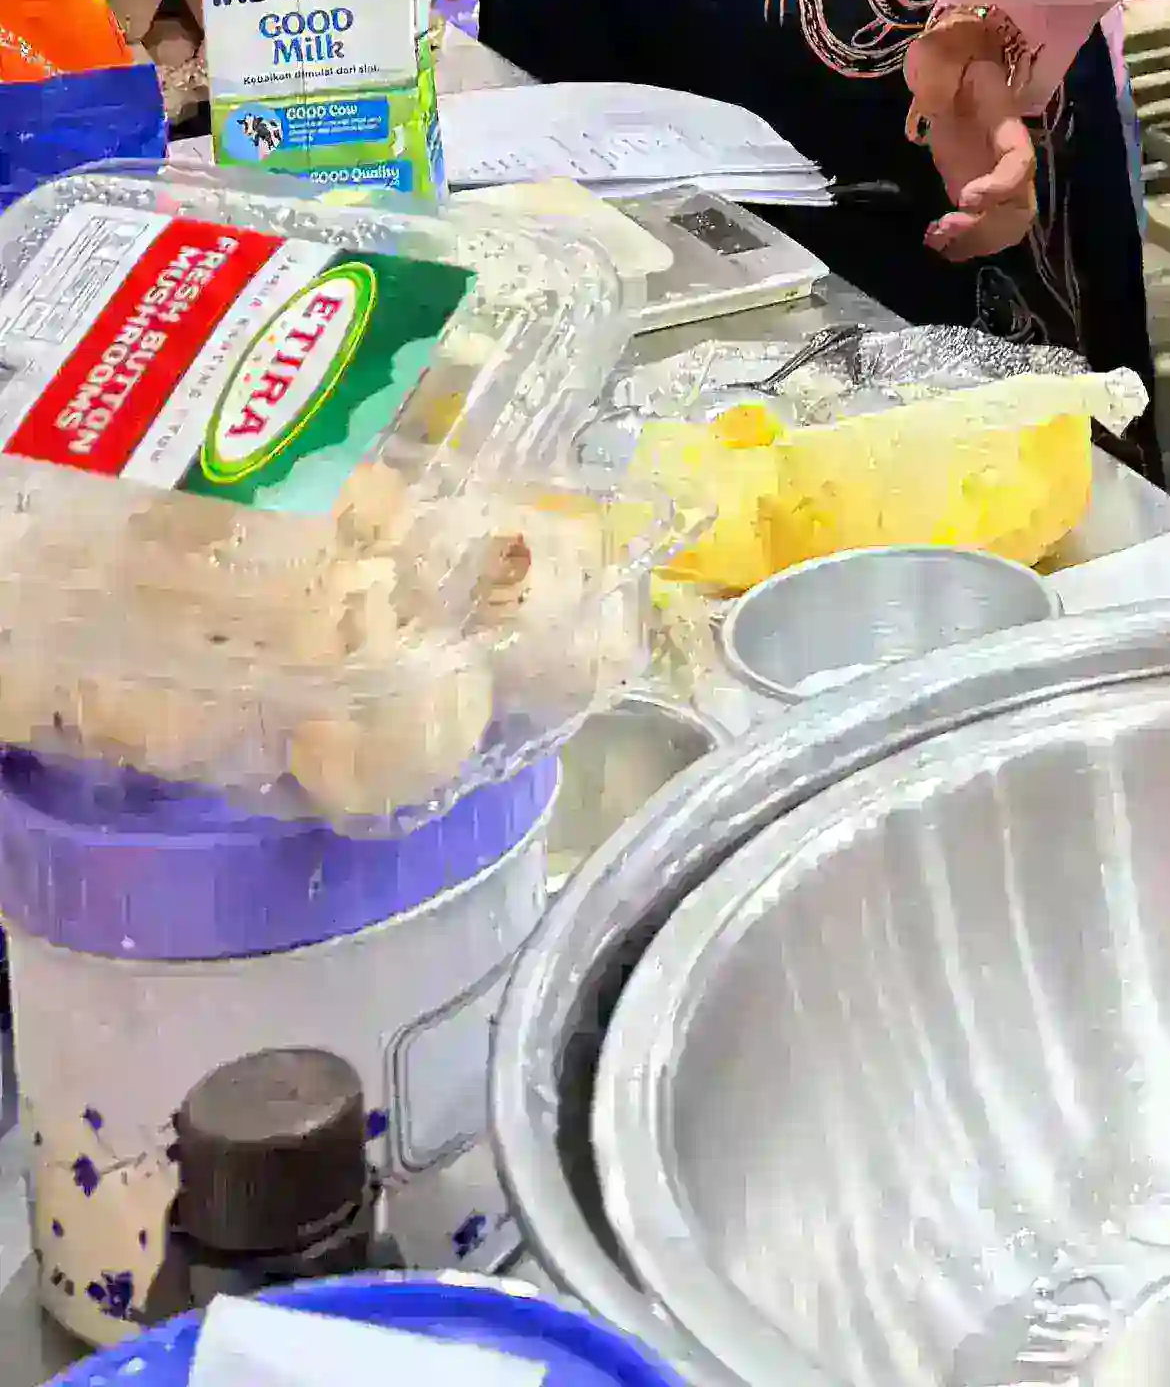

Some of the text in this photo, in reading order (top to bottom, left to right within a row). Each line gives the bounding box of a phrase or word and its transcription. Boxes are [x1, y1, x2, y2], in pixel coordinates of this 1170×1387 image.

[258, 7, 354, 39] GOOD
[272, 33, 345, 66] Milk
[285, 102, 358, 120] GOOD Cow
[310, 164, 400, 184] GOOD Quality
[157, 236, 240, 324] FRESH
[53, 245, 203, 432] MUSHROOMS
[227, 289, 344, 439] ETIRA
[68, 329, 169, 455] BUTTON
